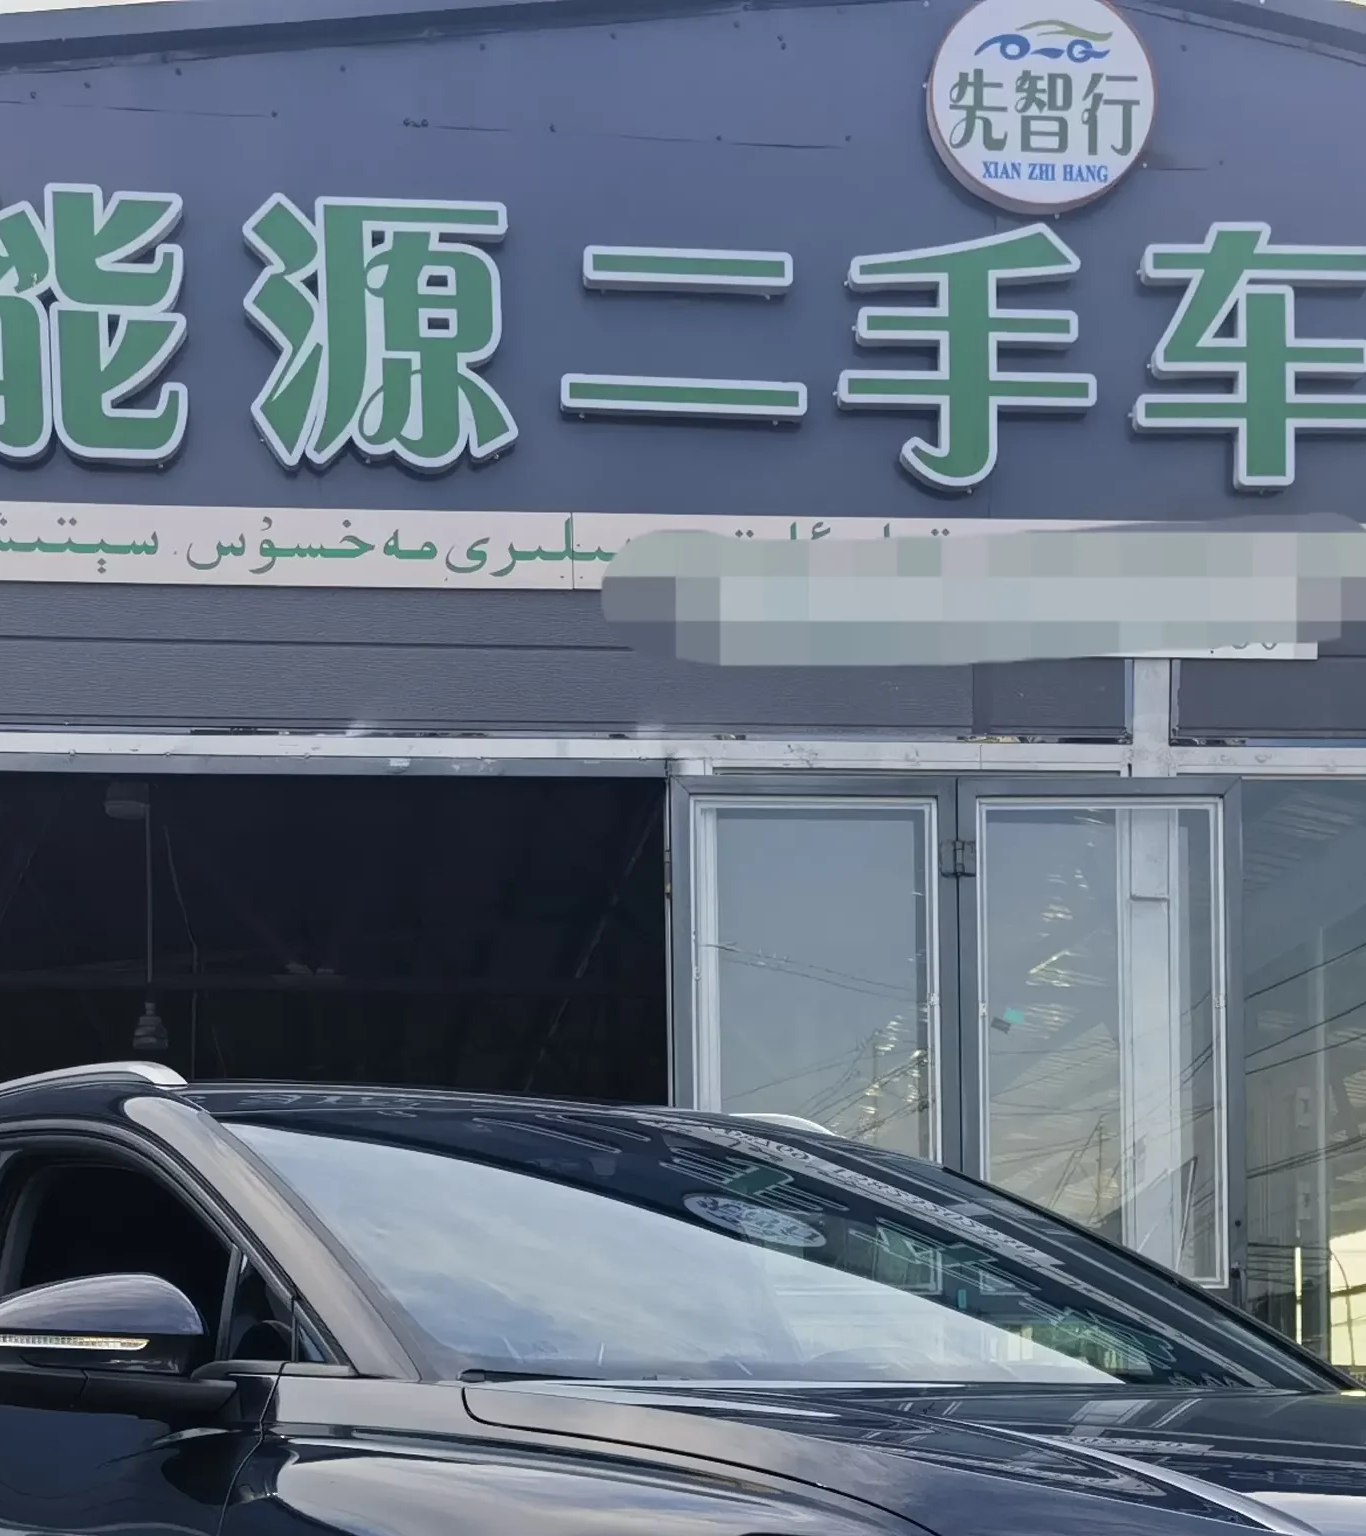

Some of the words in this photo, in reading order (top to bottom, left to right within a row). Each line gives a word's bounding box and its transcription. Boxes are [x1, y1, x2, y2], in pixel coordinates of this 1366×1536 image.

[949, 68, 1141, 156] 先智行
[981, 160, 1022, 180] XIAN
[1027, 161, 1057, 182] ZHI
[1062, 163, 1109, 184] HANG
